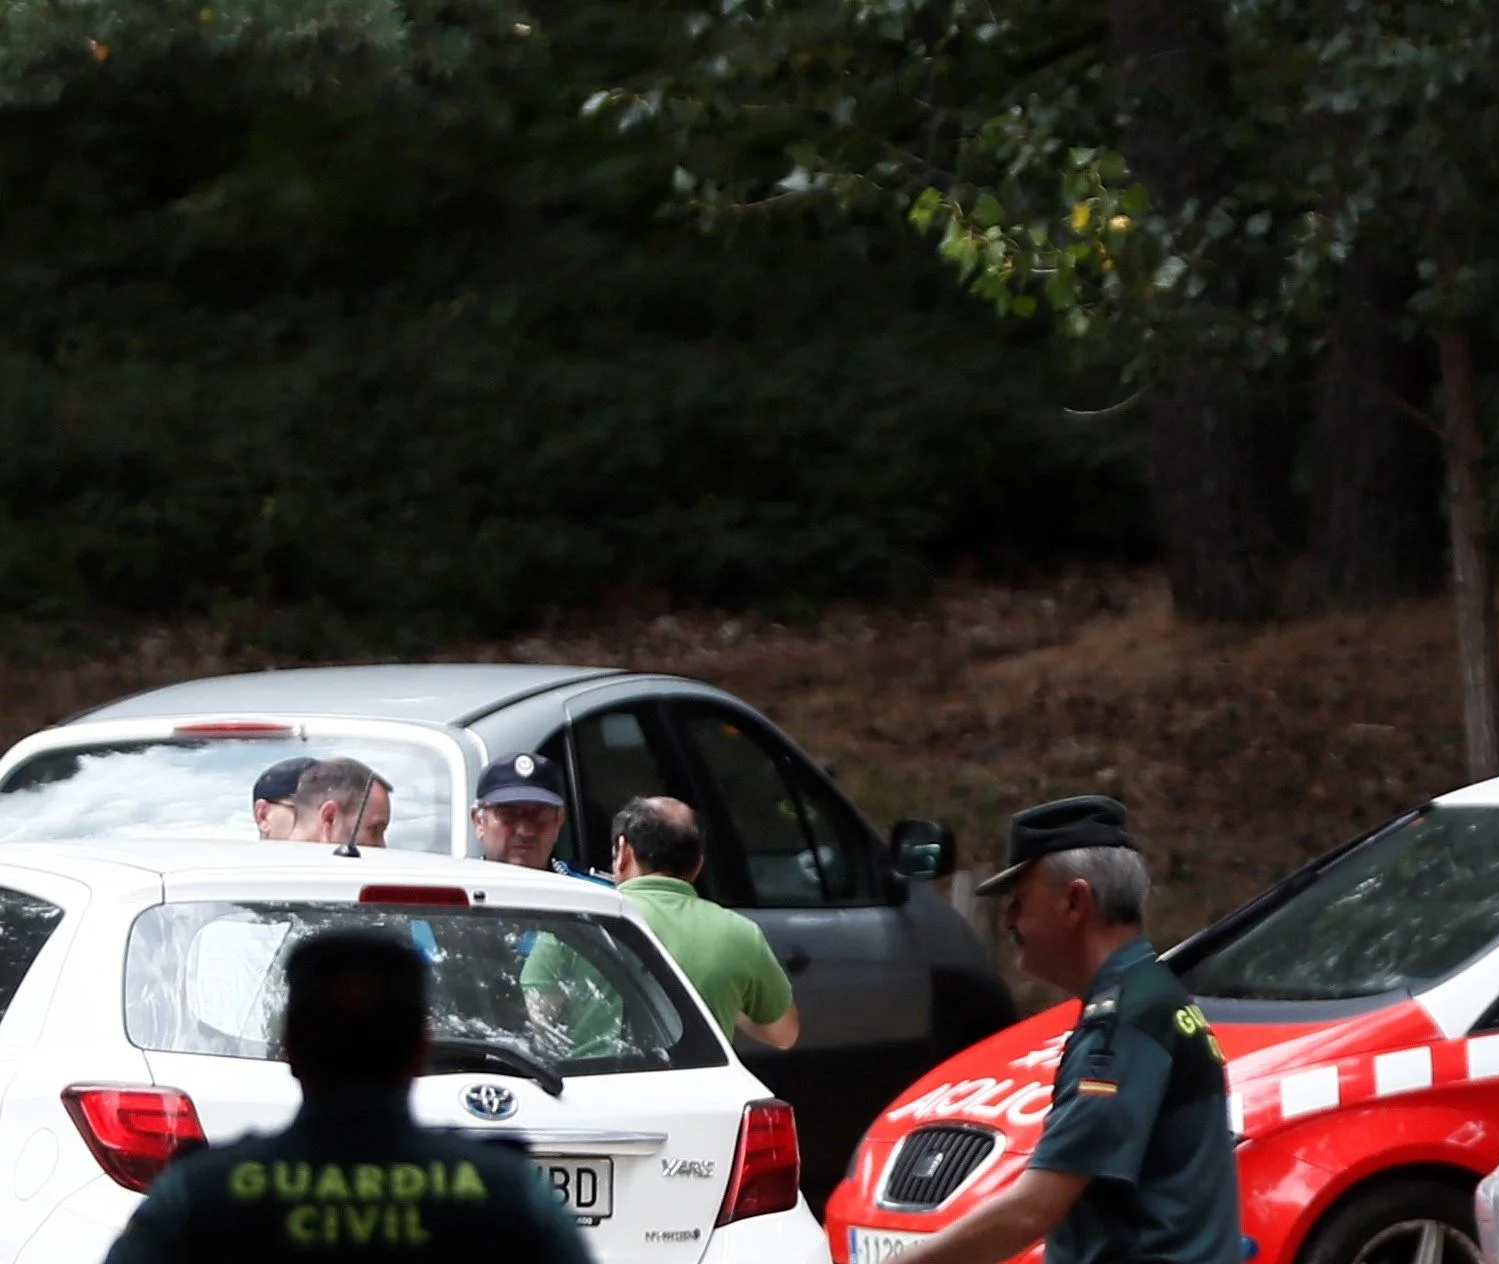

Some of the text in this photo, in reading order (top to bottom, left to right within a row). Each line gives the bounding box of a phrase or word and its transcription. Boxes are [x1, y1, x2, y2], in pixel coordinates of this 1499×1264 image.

[228, 1159, 488, 1200] GUARDIA
[536, 1165, 598, 1208] BD
[286, 1203, 430, 1244] CIVIL
